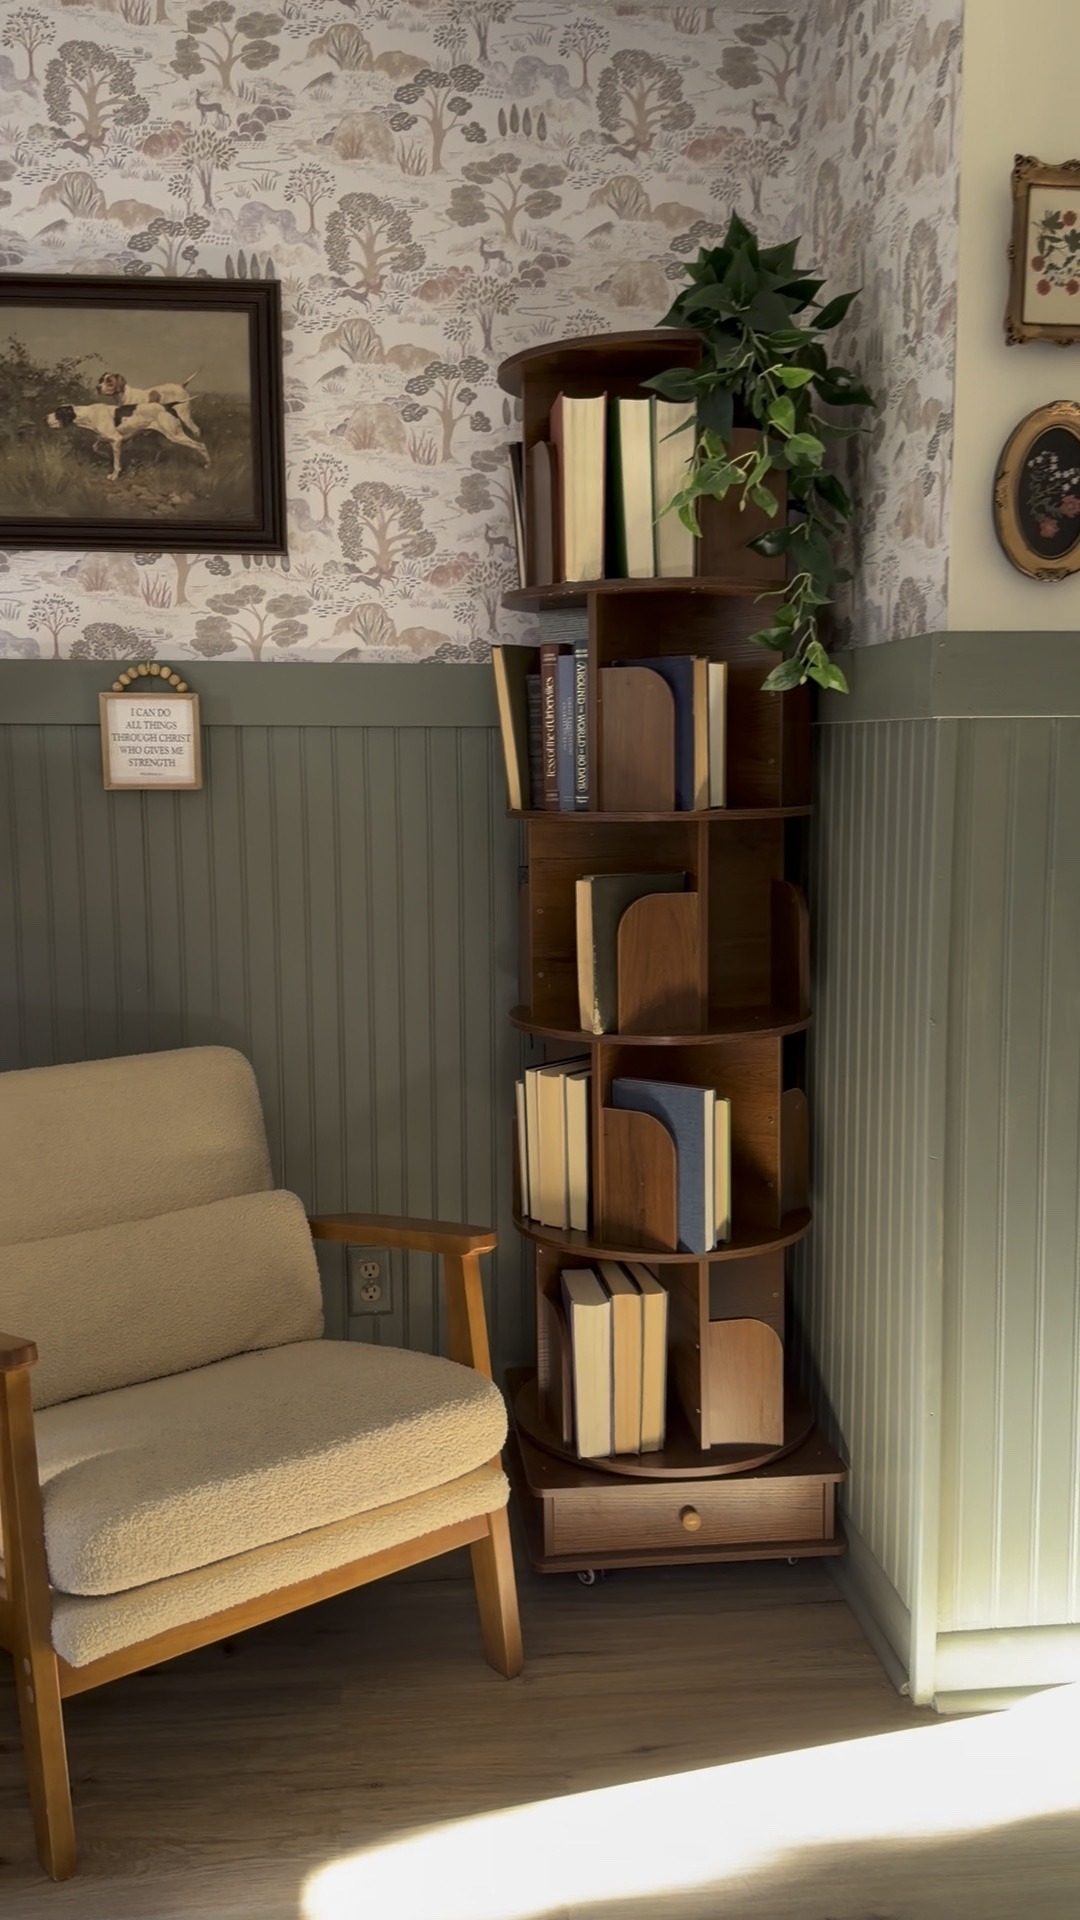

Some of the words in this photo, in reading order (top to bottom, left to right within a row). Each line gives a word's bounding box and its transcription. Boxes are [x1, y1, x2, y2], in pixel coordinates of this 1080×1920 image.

[576, 664, 587, 704] AROUND
[131, 708, 135, 717] I
[136, 708, 156, 717] CAN
[157, 708, 171, 717] DO
[125, 721, 142, 730] ALL
[144, 721, 177, 730] THINGS
[577, 714, 586, 747] WORLD
[111, 733, 158, 742] THROUGH
[159, 734, 191, 743] CHRIST
[546, 732, 555, 747] the
[120, 746, 142, 755] WHO
[143, 746, 170, 755] GIVES
[171, 746, 184, 755] ME
[546, 747, 556, 758] of
[128, 758, 176, 768] STRENGTH
[577, 754, 586, 766] 80
[546, 758, 556, 777] Tess
[576, 767, 587, 790] DAYS
